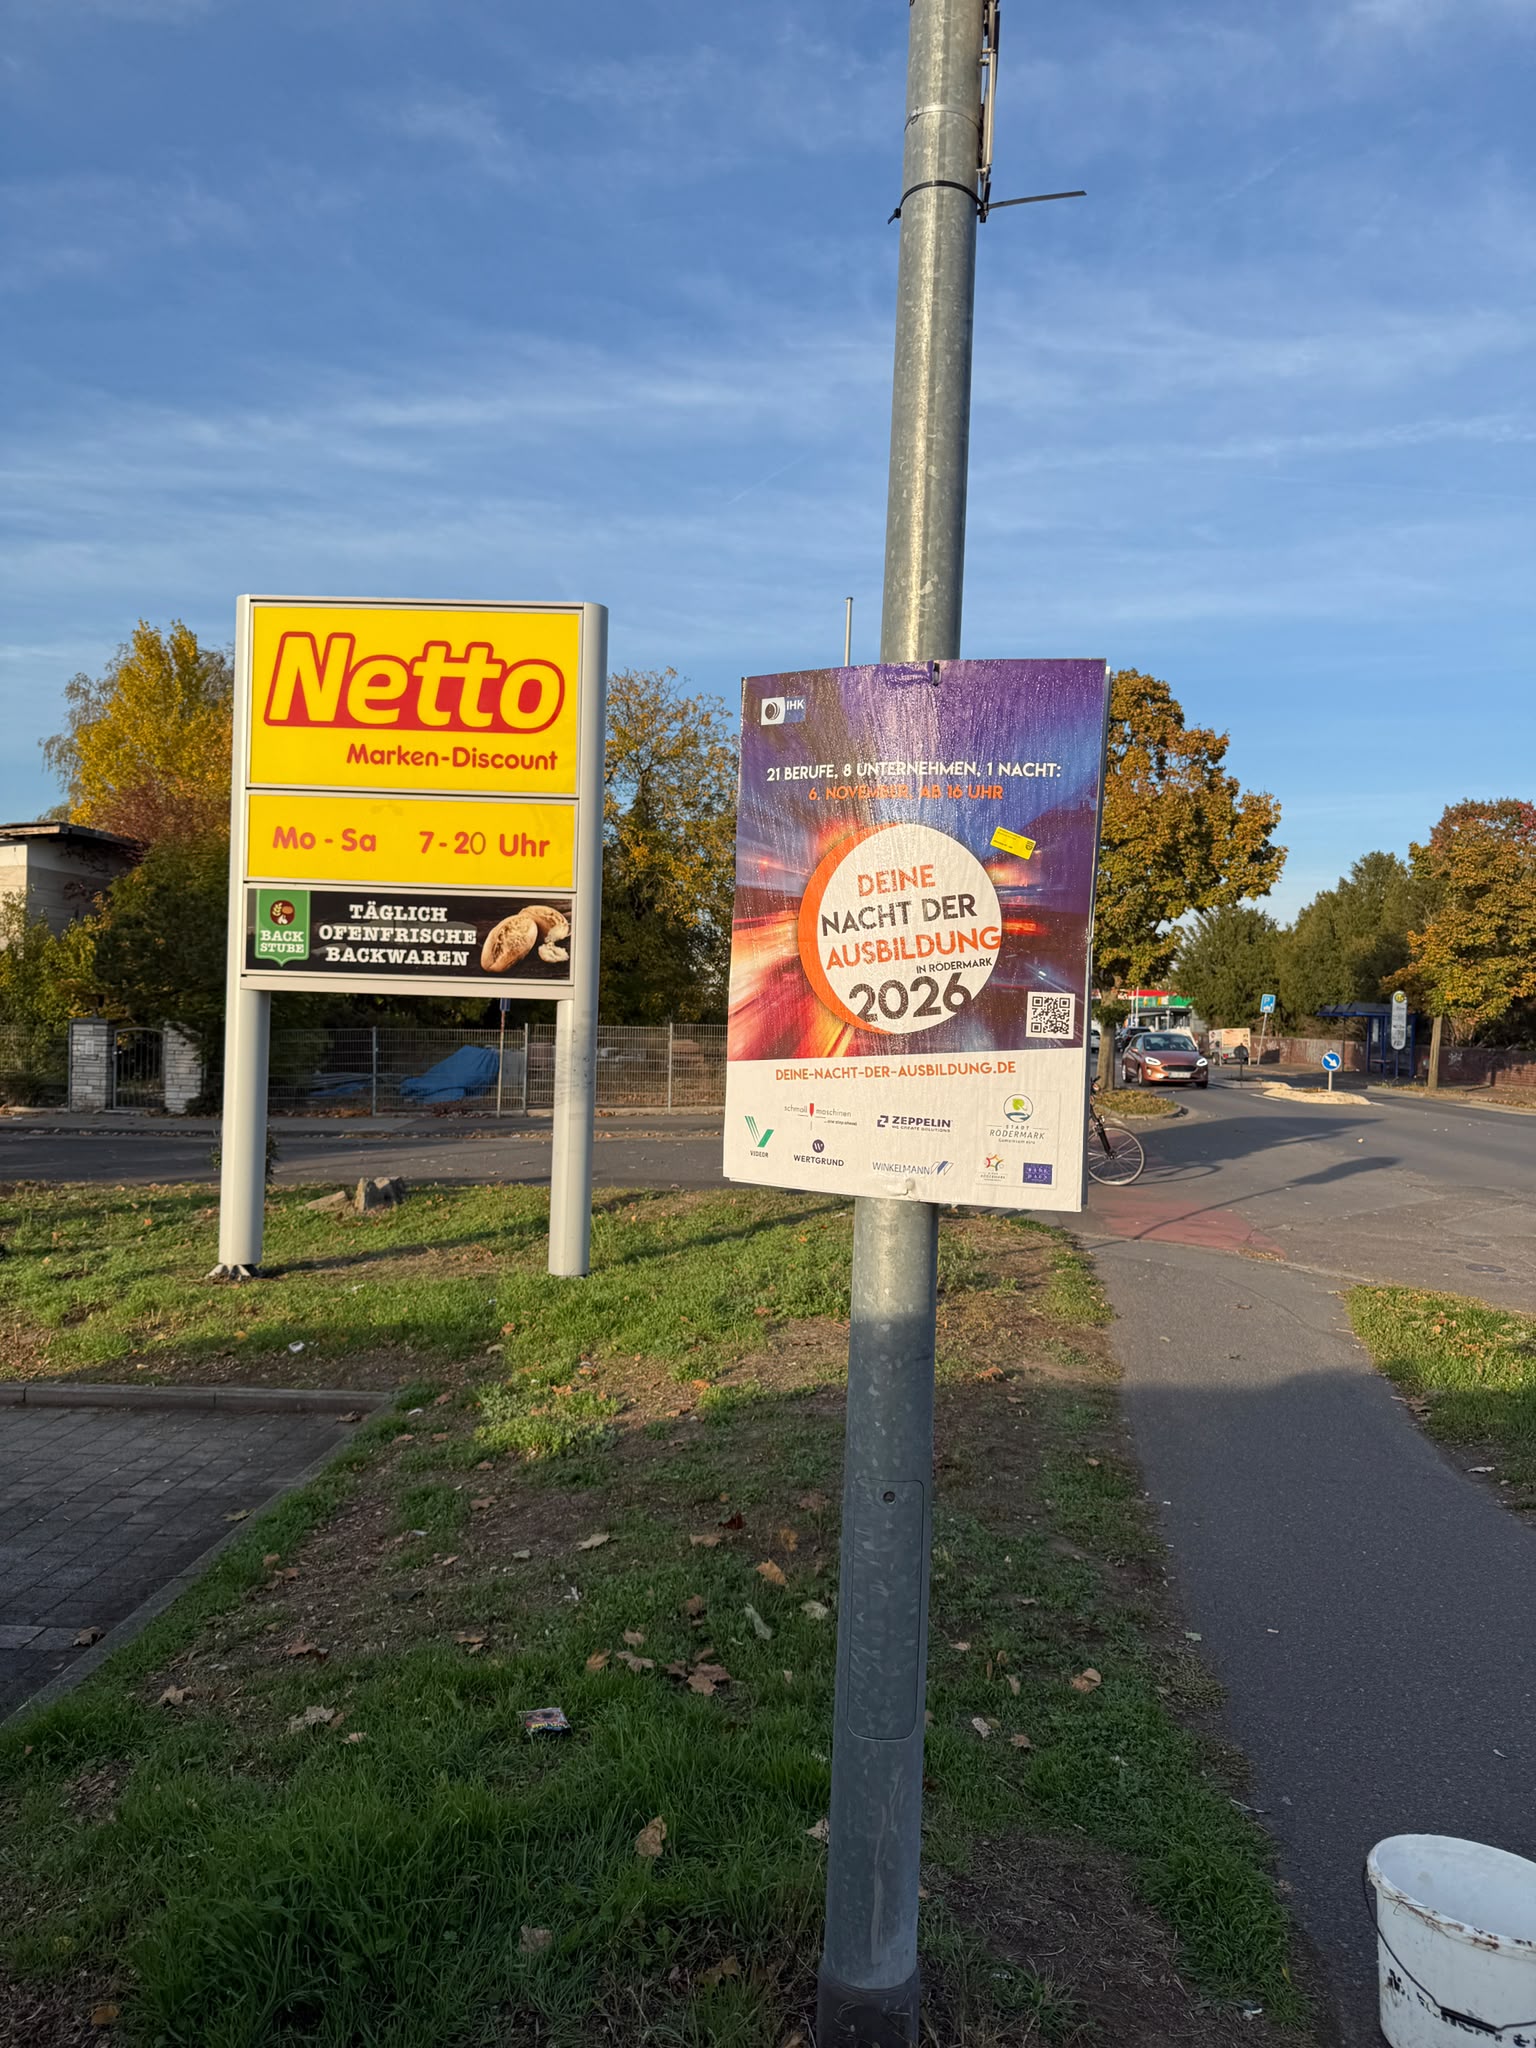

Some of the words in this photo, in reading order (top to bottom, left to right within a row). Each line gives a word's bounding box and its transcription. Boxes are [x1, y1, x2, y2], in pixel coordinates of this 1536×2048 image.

[264, 631, 565, 734] Netto
[786, 699, 804, 710] IHK
[346, 743, 558, 771] Marken-Discount
[766, 767, 780, 782] 21
[784, 764, 839, 780] BERUFE,
[843, 764, 852, 777] 8
[856, 761, 981, 778] UNTERNEHMEN,
[986, 762, 993, 775] 1
[998, 762, 1062, 778] NACHT:
[920, 784, 942, 799] AB
[947, 784, 963, 799] 16
[968, 785, 1004, 800] UHR
[272, 825, 316, 850] Mo
[341, 828, 377, 852] Sa
[499, 832, 550, 858] Uhr
[857, 864, 936, 897] DEINE
[349, 900, 447, 921] TÄGLICH
[821, 900, 912, 936] NACHT
[922, 893, 977, 922] DER
[259, 929, 304, 942] BACK
[318, 924, 477, 945] OFENFRISCHE
[259, 941, 305, 954] STUBE
[325, 946, 470, 966] BACKWAREN
[826, 926, 1000, 970] AUSBILDUNG
[916, 964, 927, 974] IN
[849, 972, 972, 1022] 2026
[775, 1061, 1016, 1081] DEINE-NACHT-DER-AUSBILDUNG.DE
[892, 1115, 951, 1128] ZEPPELIN
[793, 1154, 844, 1167] WERTGRUND
[872, 1161, 931, 1175] WINKELMANN
